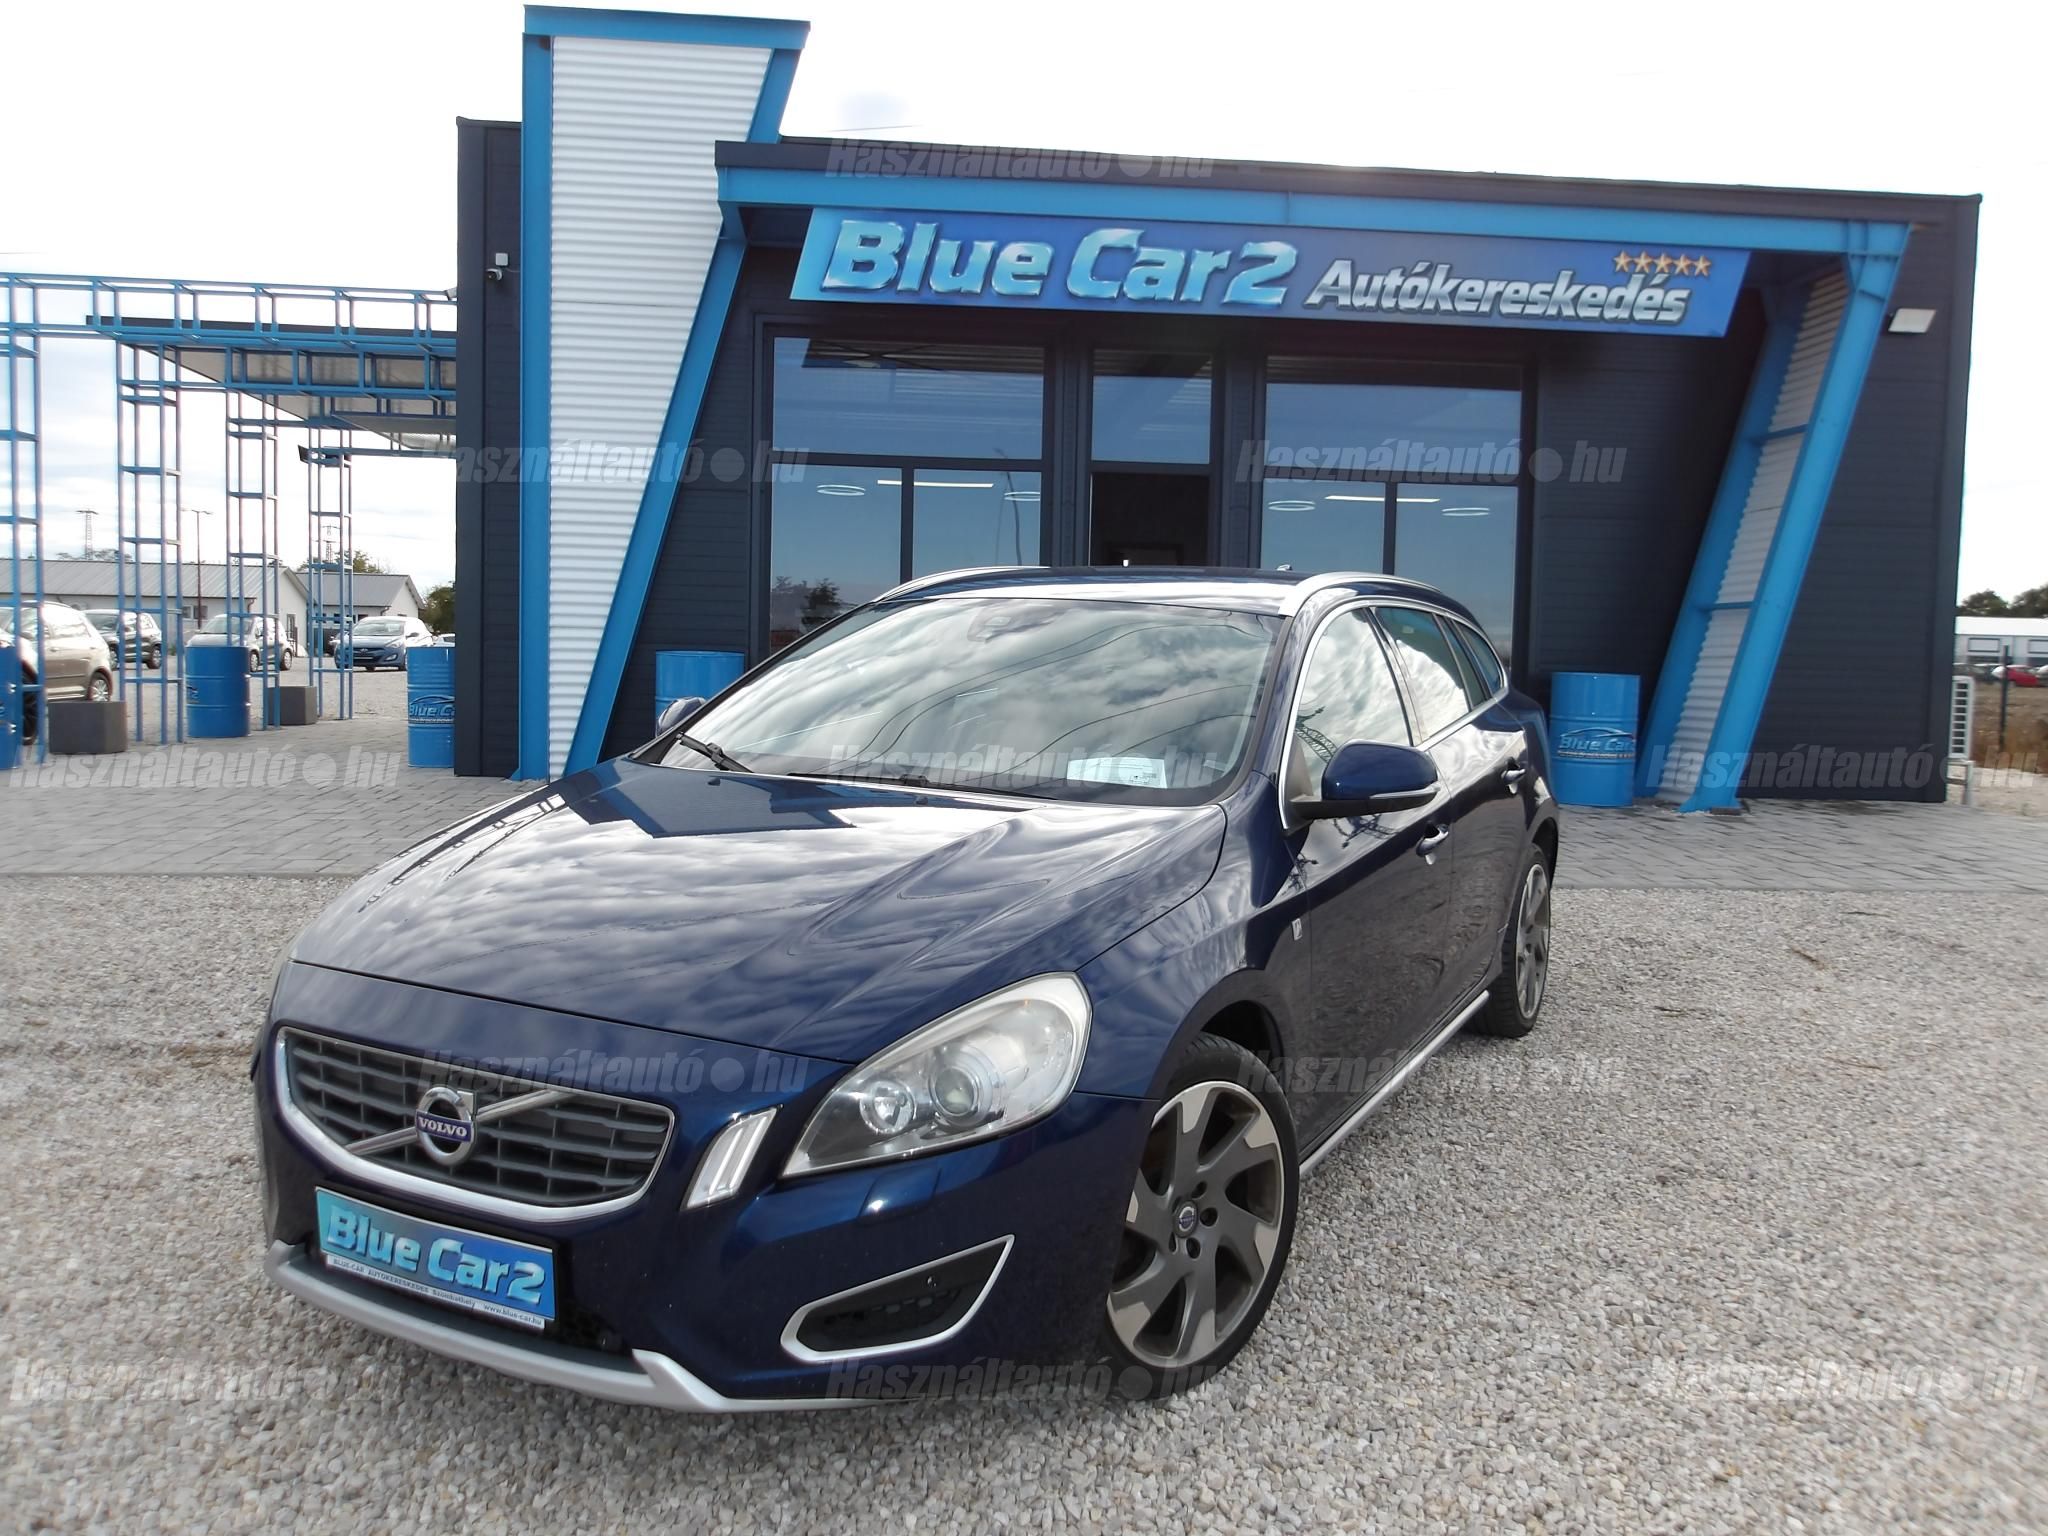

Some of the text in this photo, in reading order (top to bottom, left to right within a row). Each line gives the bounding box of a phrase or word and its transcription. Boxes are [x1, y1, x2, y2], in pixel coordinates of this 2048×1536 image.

[821, 218, 1692, 325] Blue Car2 Autókereskedés
[1559, 736, 1601, 751] Blue
[417, 1116, 468, 1138] VOLVO
[326, 1209, 546, 1306] Blue Car2
